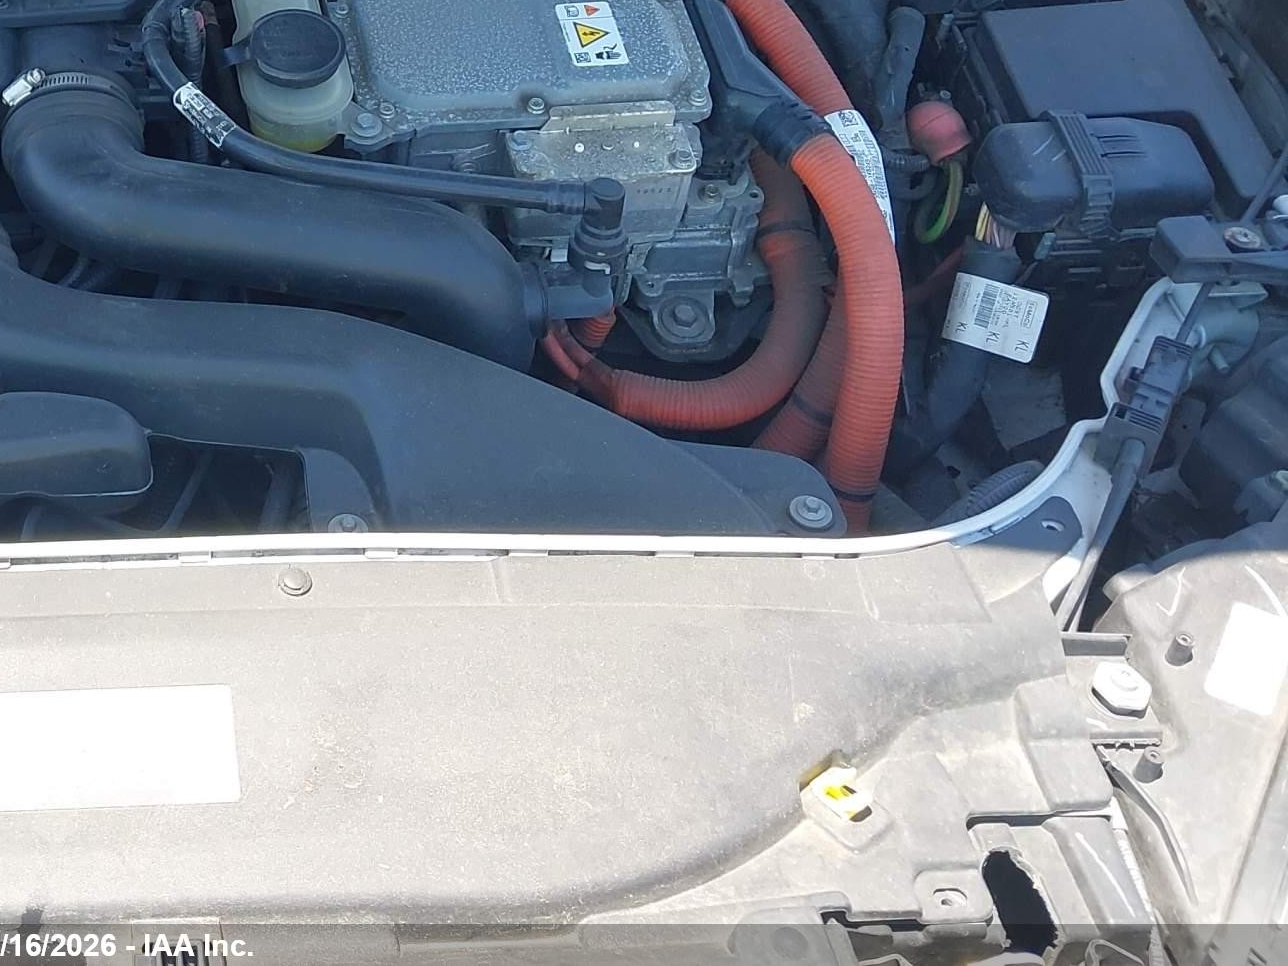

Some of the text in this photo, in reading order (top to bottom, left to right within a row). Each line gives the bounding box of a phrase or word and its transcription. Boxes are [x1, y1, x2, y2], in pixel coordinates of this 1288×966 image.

[955, 321, 969, 333] KL
[985, 331, 1000, 344] KL
[1014, 339, 1030, 352] KL
